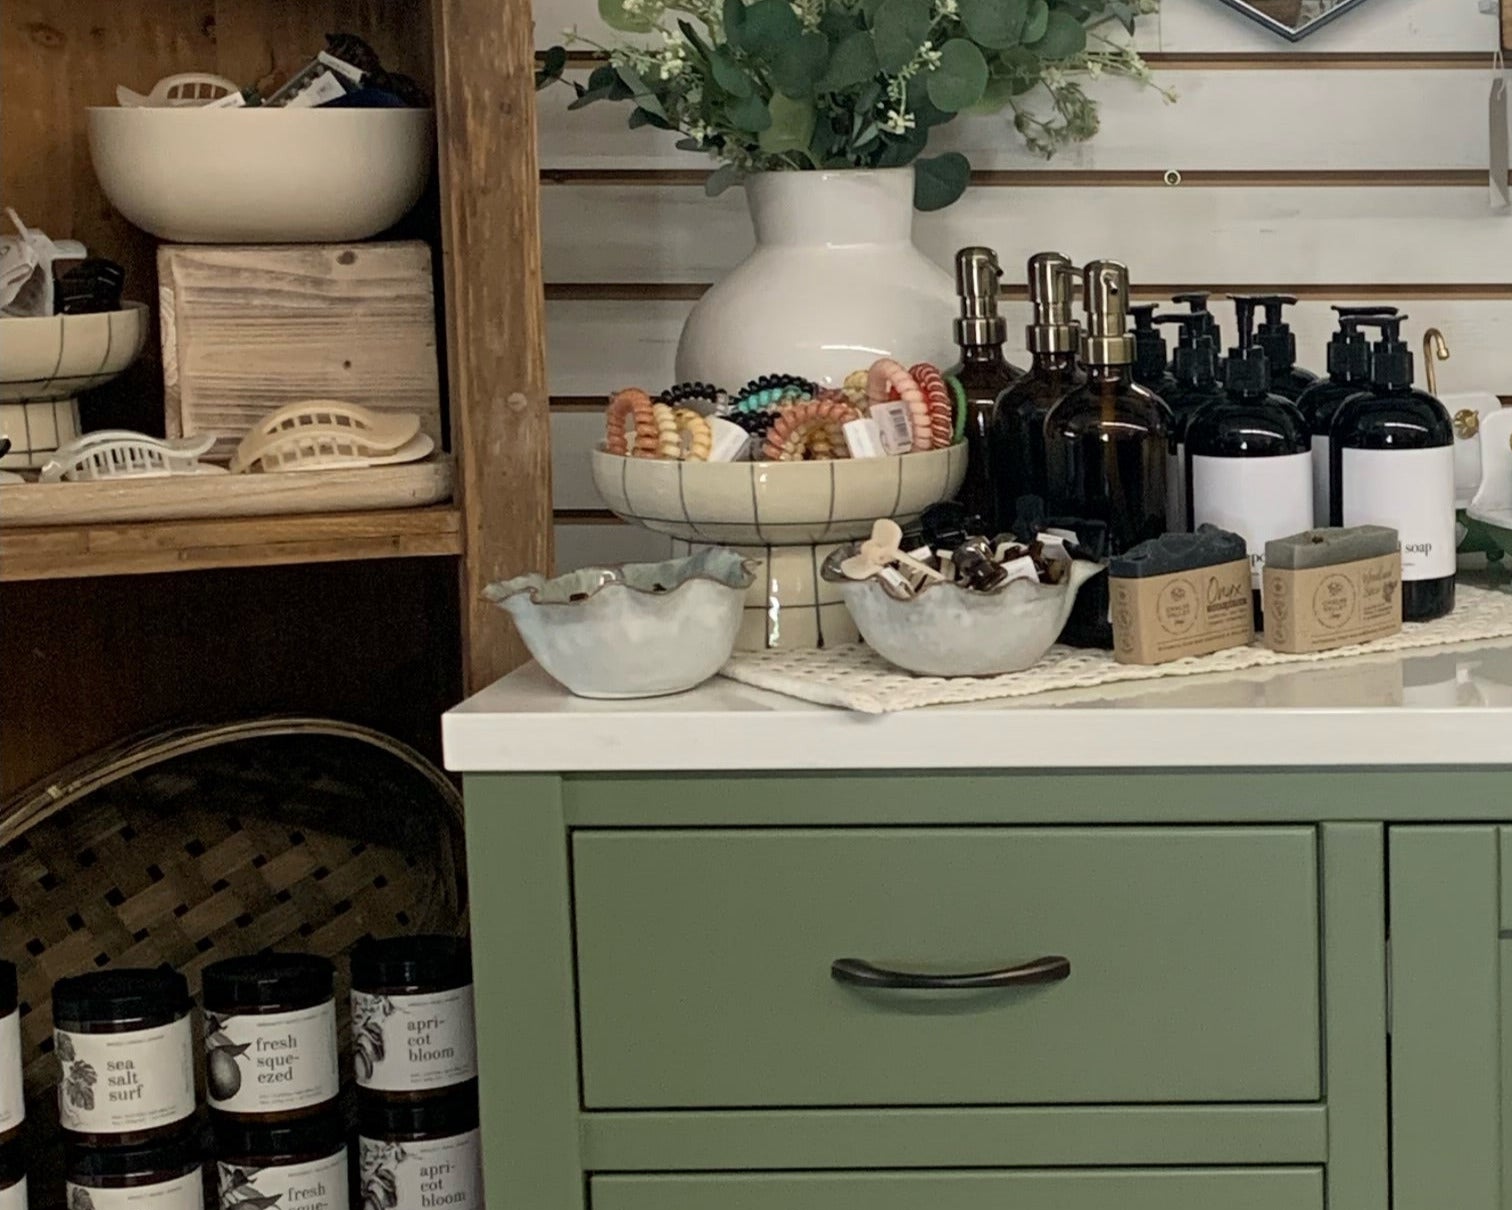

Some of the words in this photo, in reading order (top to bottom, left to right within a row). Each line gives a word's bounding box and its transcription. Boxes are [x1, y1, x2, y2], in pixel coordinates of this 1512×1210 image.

[1405, 543, 1432, 557] soap
[407, 1016, 445, 1034] apri-
[256, 1034, 297, 1052] fresh
[407, 1034, 432, 1047] cot
[257, 1054, 299, 1071] sque-
[408, 1047, 455, 1062] bloom
[106, 1060, 135, 1071] sea
[107, 1071, 138, 1086] salt
[257, 1066, 293, 1083] ezed
[108, 1083, 144, 1101] surf
[420, 1161, 456, 1180] apri-
[288, 1181, 326, 1201] fresh
[420, 1178, 443, 1193] cot
[421, 1191, 467, 1208] bloom
